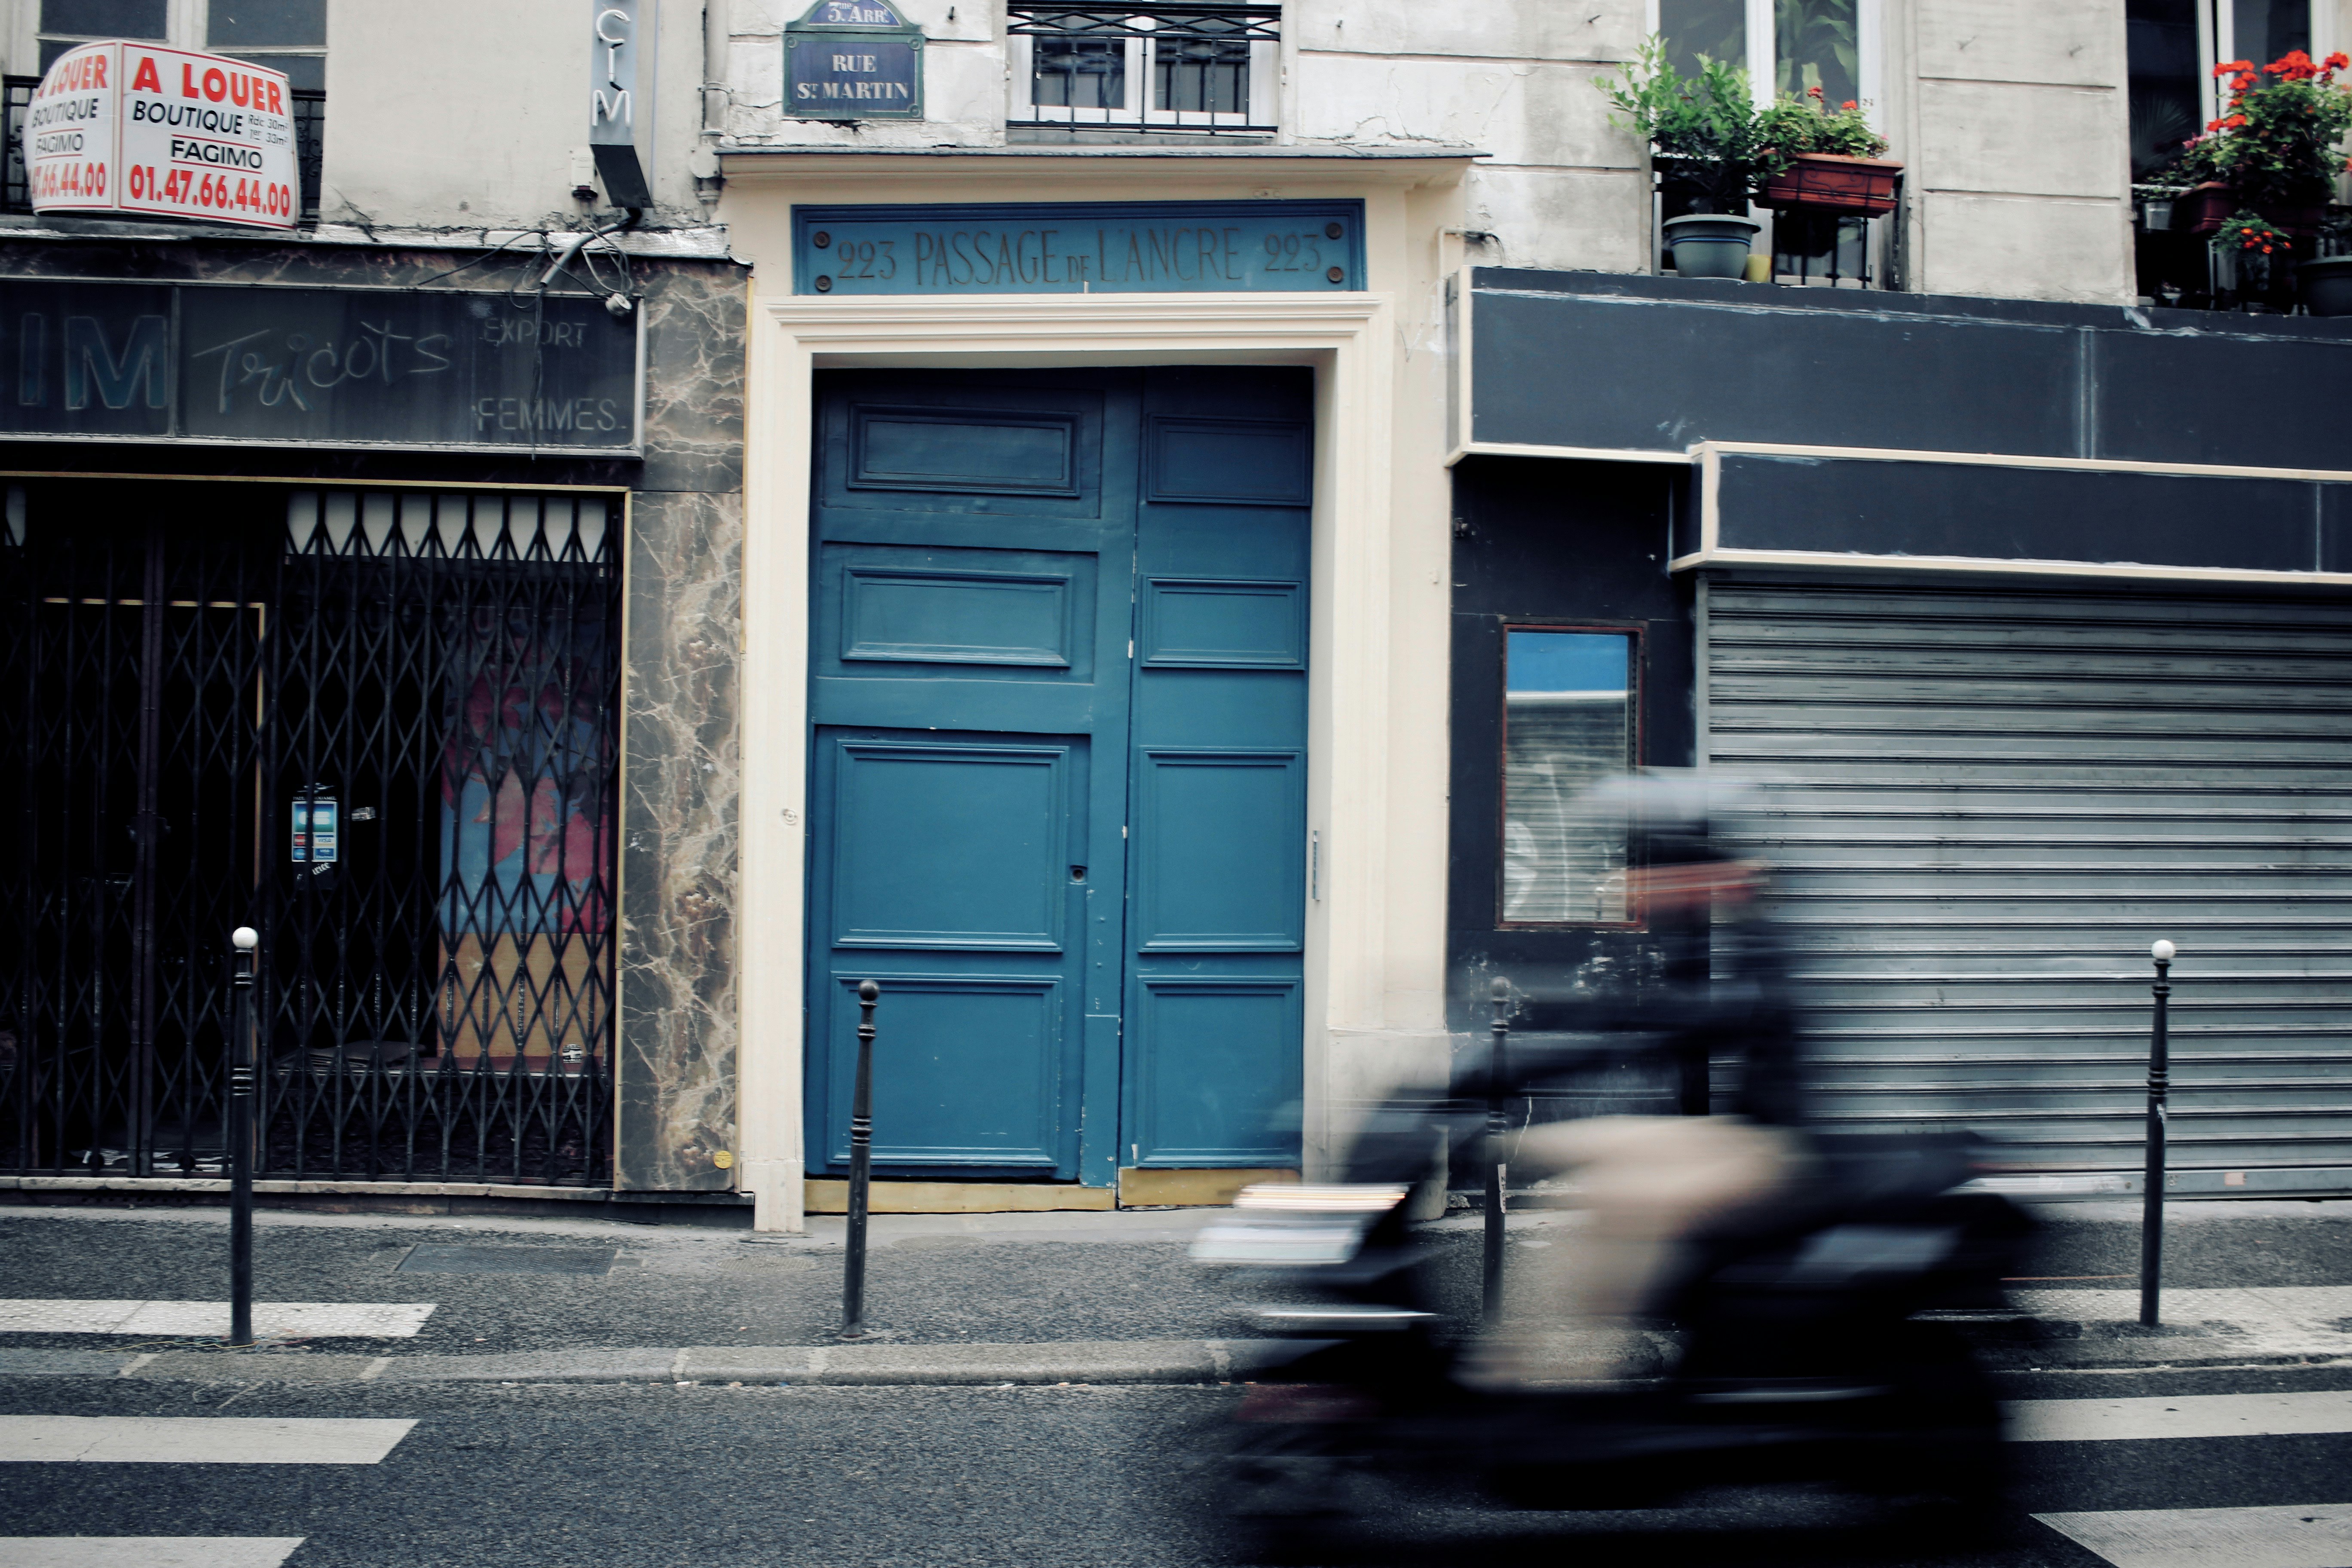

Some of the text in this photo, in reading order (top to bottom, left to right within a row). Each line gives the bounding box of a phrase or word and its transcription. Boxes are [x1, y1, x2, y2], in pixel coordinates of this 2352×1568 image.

[49, 54, 107, 96] LOUER
[592, 9, 631, 127] CIM
[832, 55, 877, 72] RUE
[132, 56, 284, 116] A LOUER
[823, 83, 909, 99] MARTIN
[32, 98, 99, 128] BOUTIQUE
[132, 100, 243, 135] BOUTIQUE
[36, 133, 83, 155] FAGIMO
[171, 139, 263, 169] FAGIMO
[130, 164, 291, 217] 01.47.66.44.00
[837, 227, 1322, 286] 223 PASSAGE DE L'ANCRE 223
[483, 317, 588, 347] EXPORT
[478, 397, 616, 431] FEMMES
